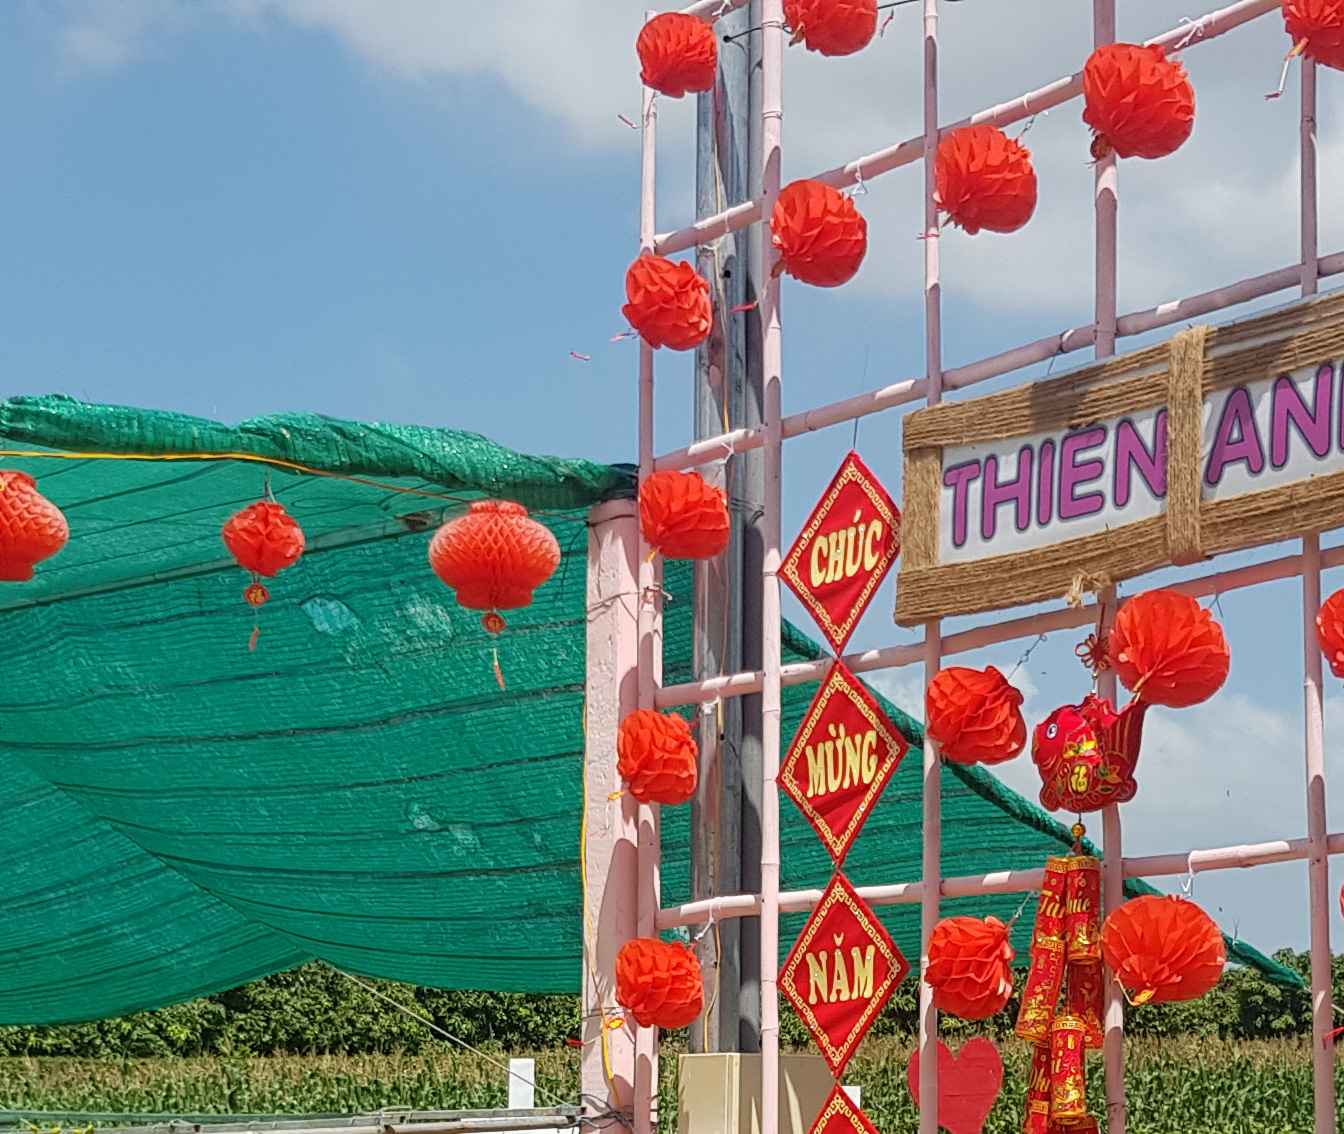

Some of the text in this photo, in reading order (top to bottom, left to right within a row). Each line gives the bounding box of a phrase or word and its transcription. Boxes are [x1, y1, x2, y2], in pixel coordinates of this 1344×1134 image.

[810, 509, 883, 588] CHÚC
[805, 723, 878, 798] MỪNG
[805, 932, 875, 1005] NĂM
